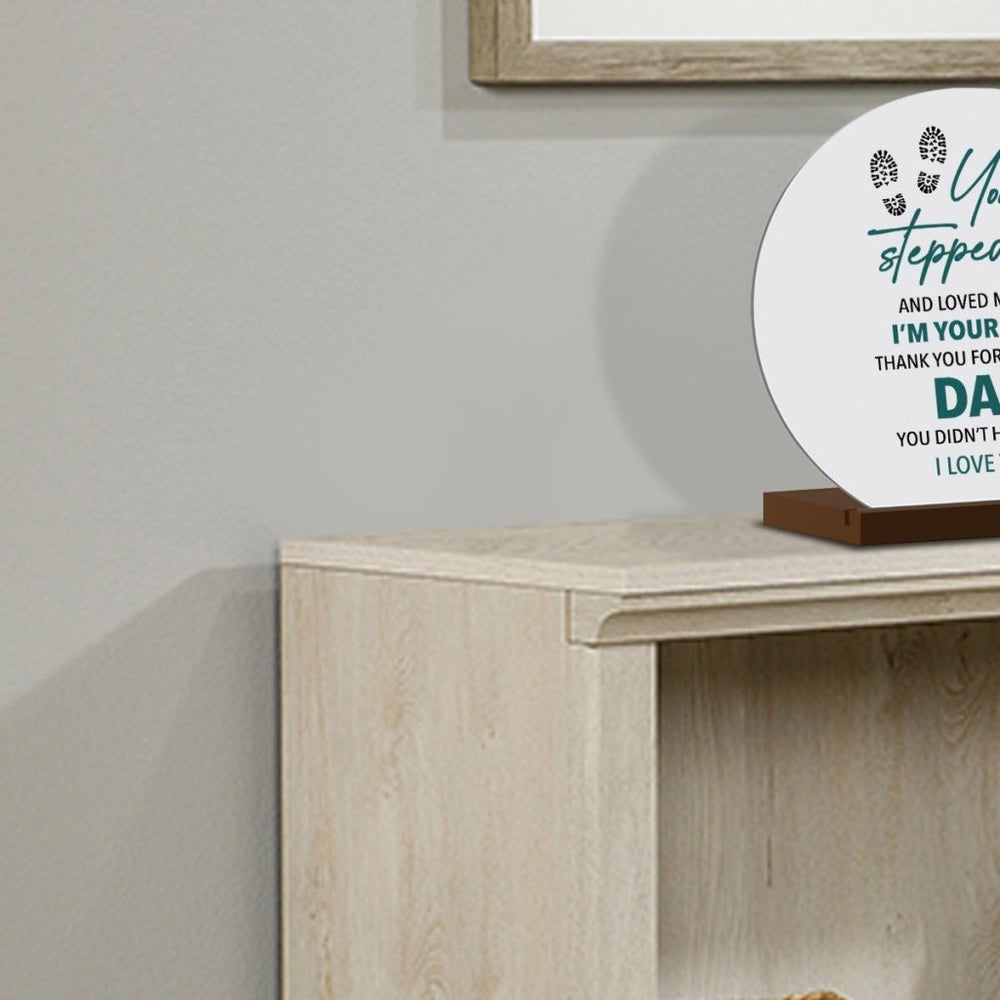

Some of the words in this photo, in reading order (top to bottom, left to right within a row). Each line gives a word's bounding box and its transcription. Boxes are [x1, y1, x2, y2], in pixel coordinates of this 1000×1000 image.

[899, 297, 933, 314] AND
[938, 293, 988, 311] LOVED
[892, 322, 928, 344] I'M
[933, 318, 999, 341] YOUR
[875, 353, 930, 371] THANK
[932, 350, 966, 367] YOU
[896, 430, 930, 447] YOU
[935, 427, 988, 444] DIDN'T
[936, 457, 941, 476] I
[947, 454, 995, 475] LOVE
